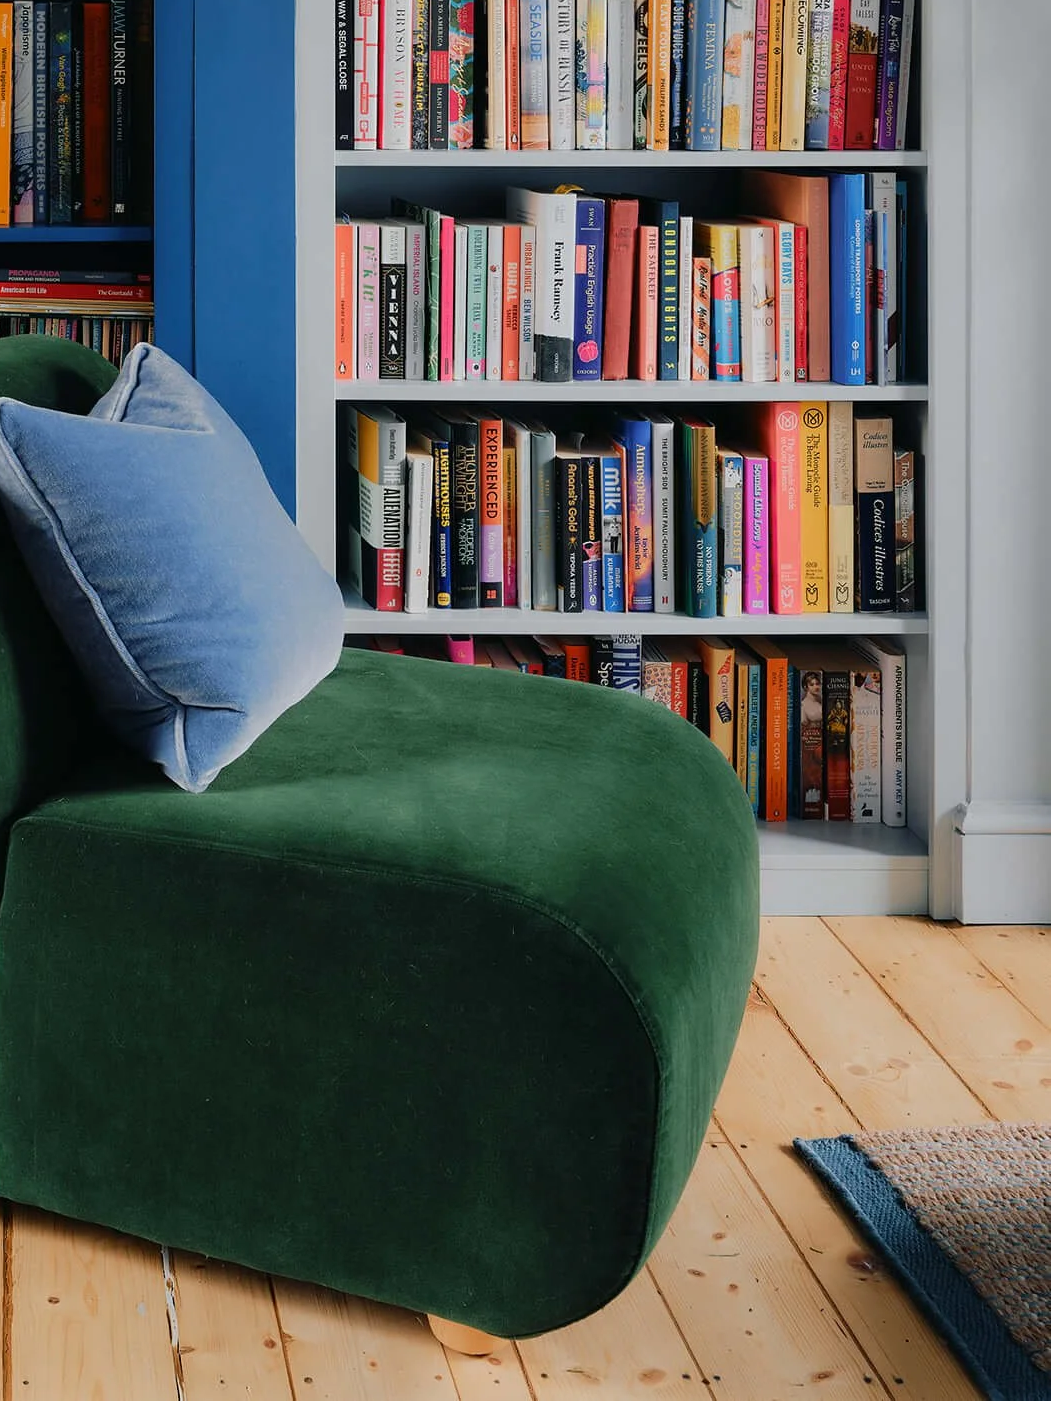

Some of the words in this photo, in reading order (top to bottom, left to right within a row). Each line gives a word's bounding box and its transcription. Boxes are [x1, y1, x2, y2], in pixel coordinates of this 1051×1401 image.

[338, 1, 346, 20] WAY
[673, 6, 685, 26] SIDE
[21, 5, 31, 56] Japonisme
[36, 11, 45, 70] MODERN
[339, 31, 347, 59] SEGAL
[530, 5, 542, 61] SEASIDE
[673, 29, 684, 59] VOICES
[705, 22, 715, 70] FEMINA
[638, 38, 647, 70] EELS
[339, 60, 347, 90] CLOSE
[36, 74, 45, 128] BRITISH
[36, 132, 45, 191] POSTERS
[554, 241, 565, 274] Frank
[587, 245, 596, 277] Practical
[665, 220, 675, 276] LONDON
[782, 232, 792, 258] GLORY
[782, 262, 792, 284] DAYS
[551, 279, 564, 323] Ramsey
[585, 280, 595, 308] English
[585, 310, 594, 335] Usage
[665, 287, 676, 342] NIGHTS
[383, 464, 402, 484] THE
[604, 467, 621, 509] milk
[635, 444, 646, 516] Atmosphere
[383, 488, 401, 547] ALIENATION
[874, 499, 885, 543] Codices
[697, 539, 703, 551] TO
[706, 547, 712, 558] NO
[383, 553, 400, 587] EFFECT
[874, 546, 885, 591] illustres
[612, 645, 640, 690] THIS
[895, 732, 902, 740] IN
